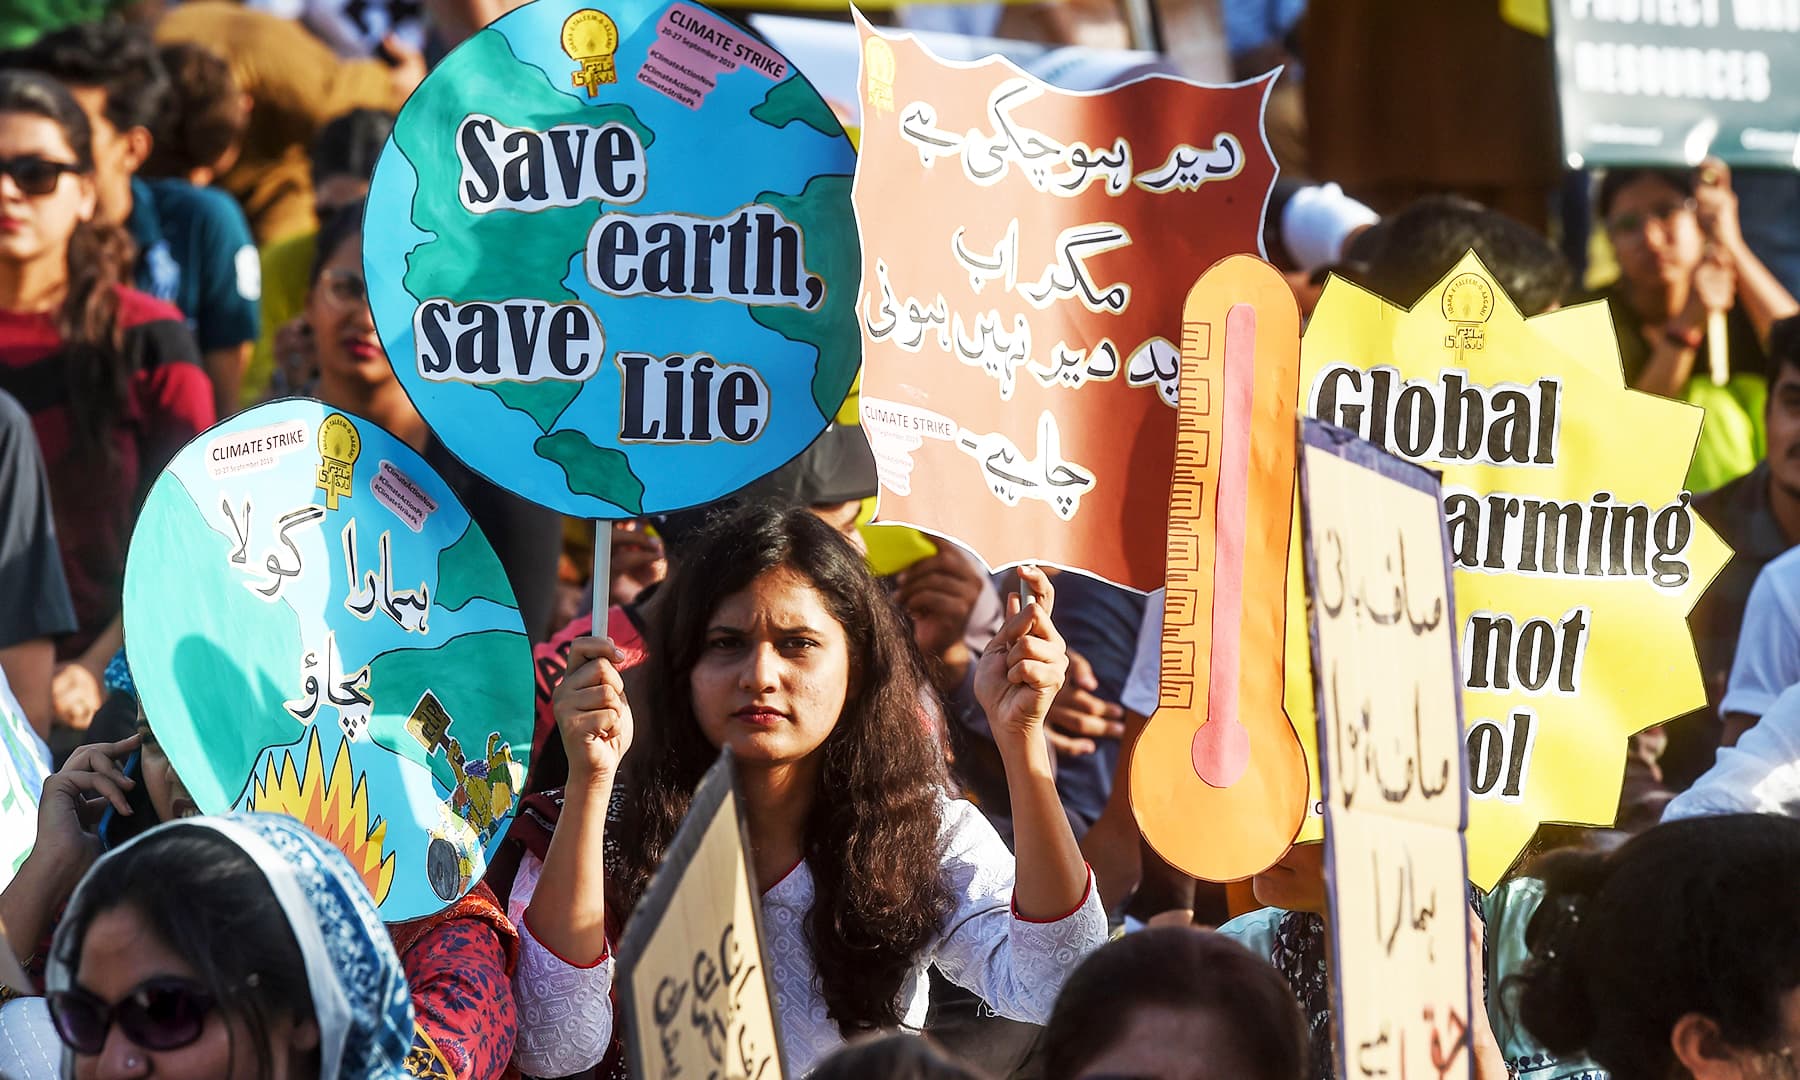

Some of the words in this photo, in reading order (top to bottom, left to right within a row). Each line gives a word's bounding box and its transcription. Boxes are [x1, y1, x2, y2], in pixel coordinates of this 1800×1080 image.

[643, 63, 703, 99] #ClimateActionPk
[649, 49, 716, 88] #ClimateActionNow
[661, 27, 682, 44] 20-27
[682, 37, 718, 61] September
[718, 56, 736, 70] 2019
[670, 10, 733, 52] CLIMATE
[734, 43, 785, 78] STRIKE
[638, 72, 696, 107] #ClimateStrikePk
[462, 119, 636, 204] Save
[903, 108, 961, 163] ہے
[1138, 137, 1240, 189] دیر
[598, 212, 824, 309] earth,
[957, 229, 1017, 285] اب
[1028, 229, 1125, 311] مگر
[421, 302, 591, 376] save
[866, 264, 950, 347] ہونی
[956, 317, 1026, 396] نہیں
[1037, 341, 1115, 383] دیر
[620, 355, 760, 441] Life
[865, 405, 909, 428] CLIMATE
[912, 417, 952, 437] STRIKE
[1316, 368, 1558, 464] Global
[212, 439, 263, 462] CLIMATE
[266, 429, 304, 450] STRIKE
[222, 498, 326, 597] گولا
[1445, 492, 1693, 588] arming
[346, 524, 429, 633] ہمارا
[289, 634, 372, 739] بچاؤ
[1466, 609, 1586, 692] not
